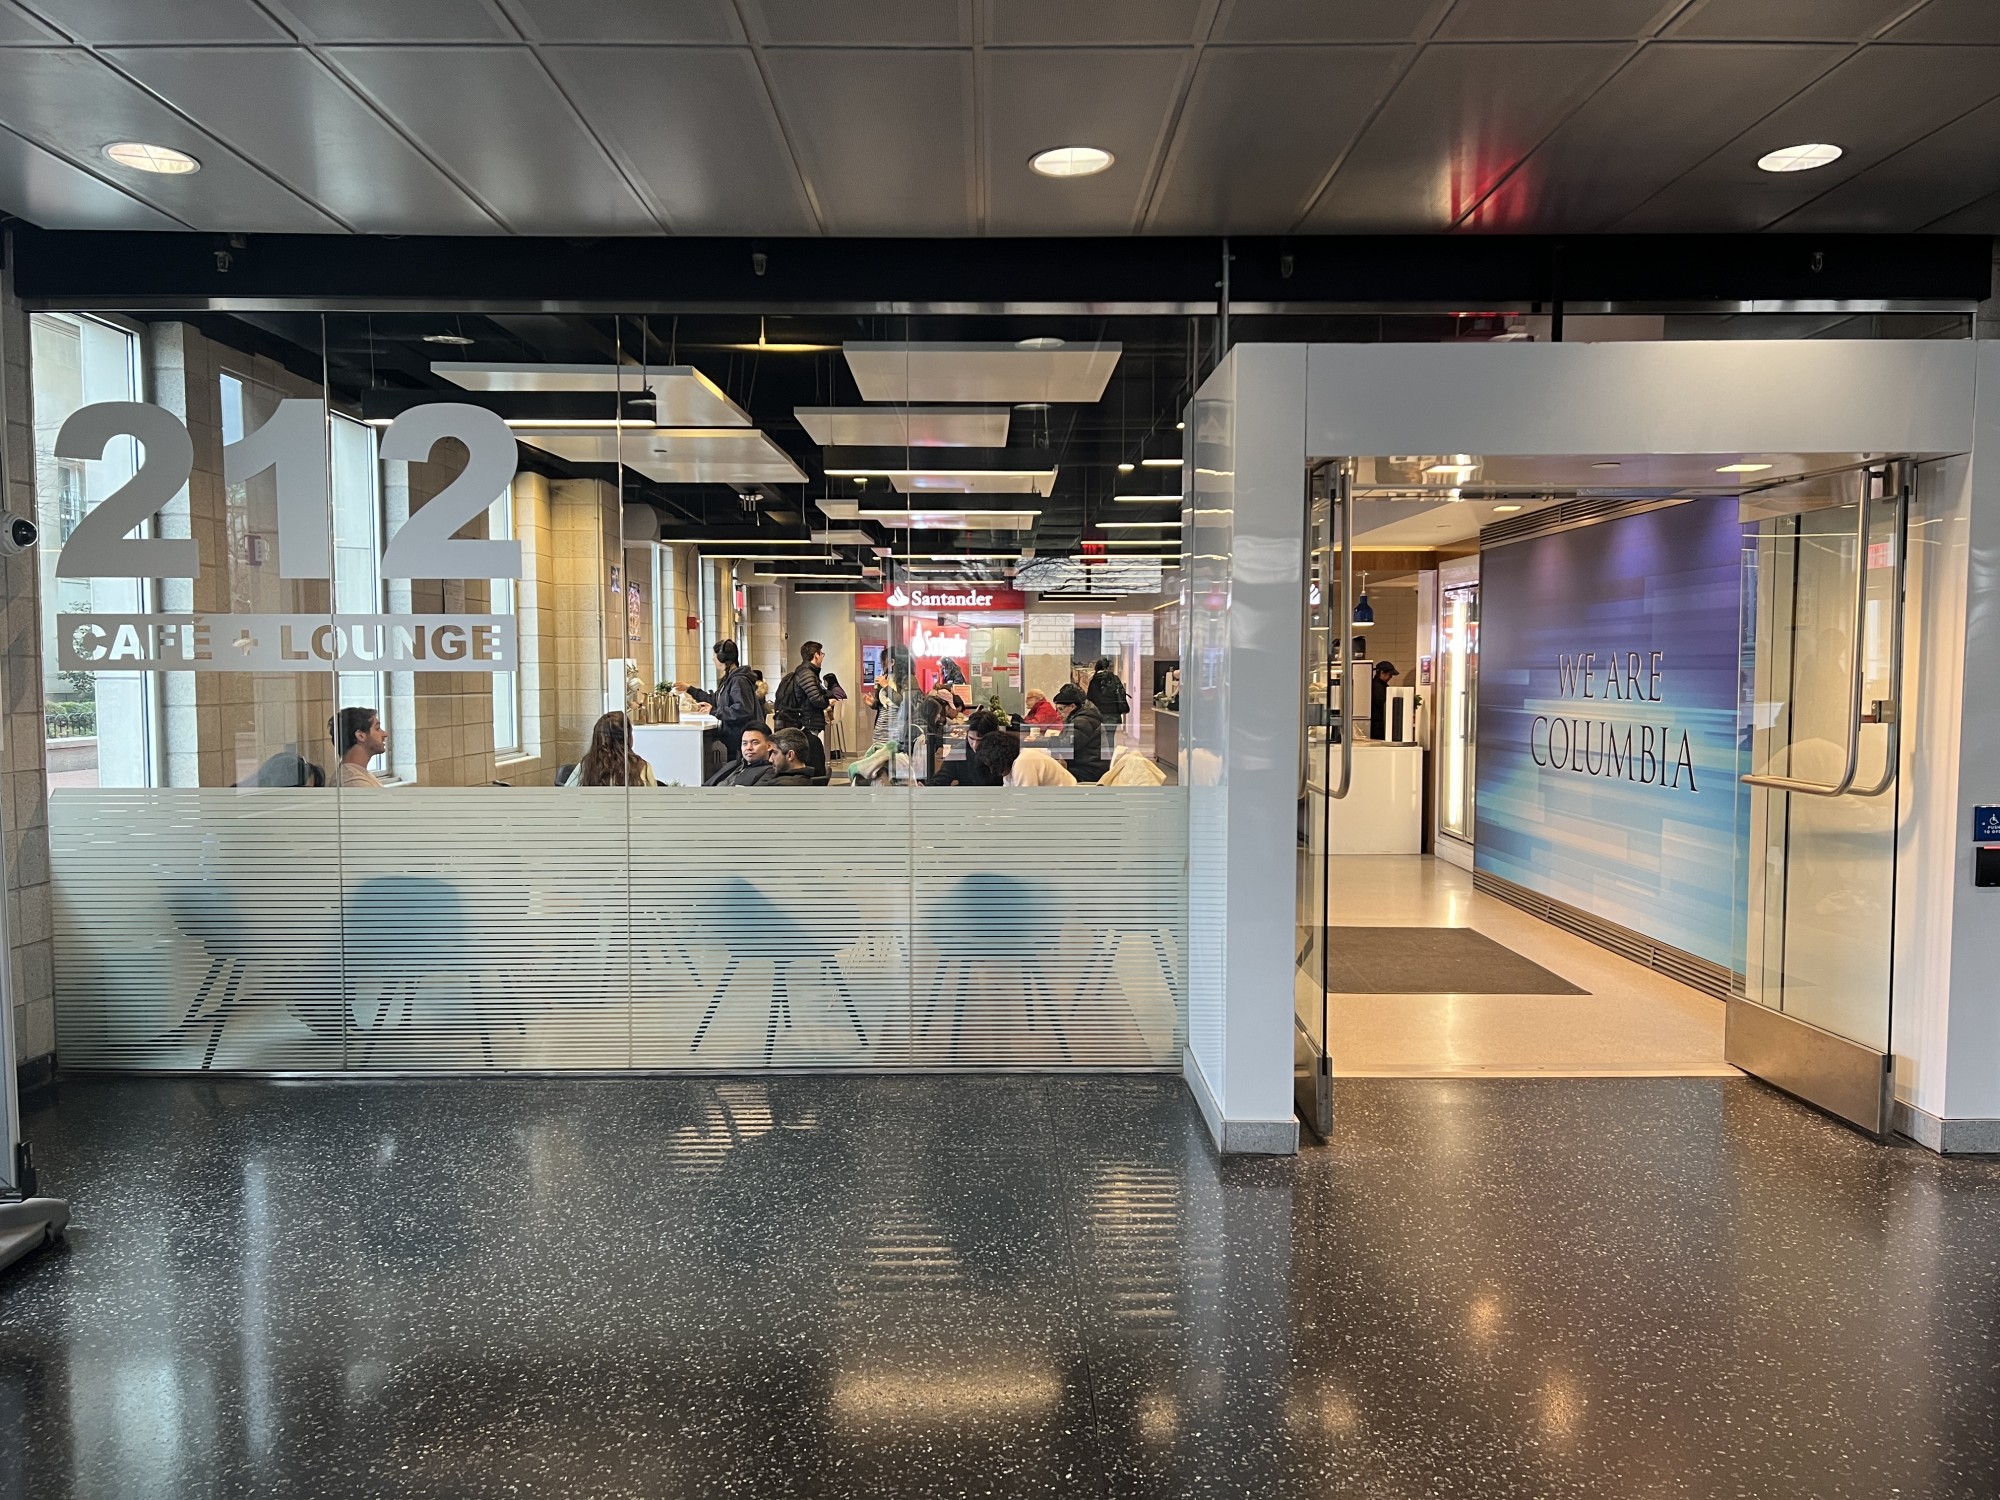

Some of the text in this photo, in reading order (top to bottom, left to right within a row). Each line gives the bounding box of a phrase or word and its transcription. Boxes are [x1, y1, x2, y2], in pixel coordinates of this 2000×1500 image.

[54, 398, 522, 579] 212
[911, 589, 993, 606] Santander
[71, 616, 503, 662] CAFÉ + LOUNGE
[1556, 651, 1664, 702] WE ARE
[1530, 716, 1699, 793] COLUMBIA
